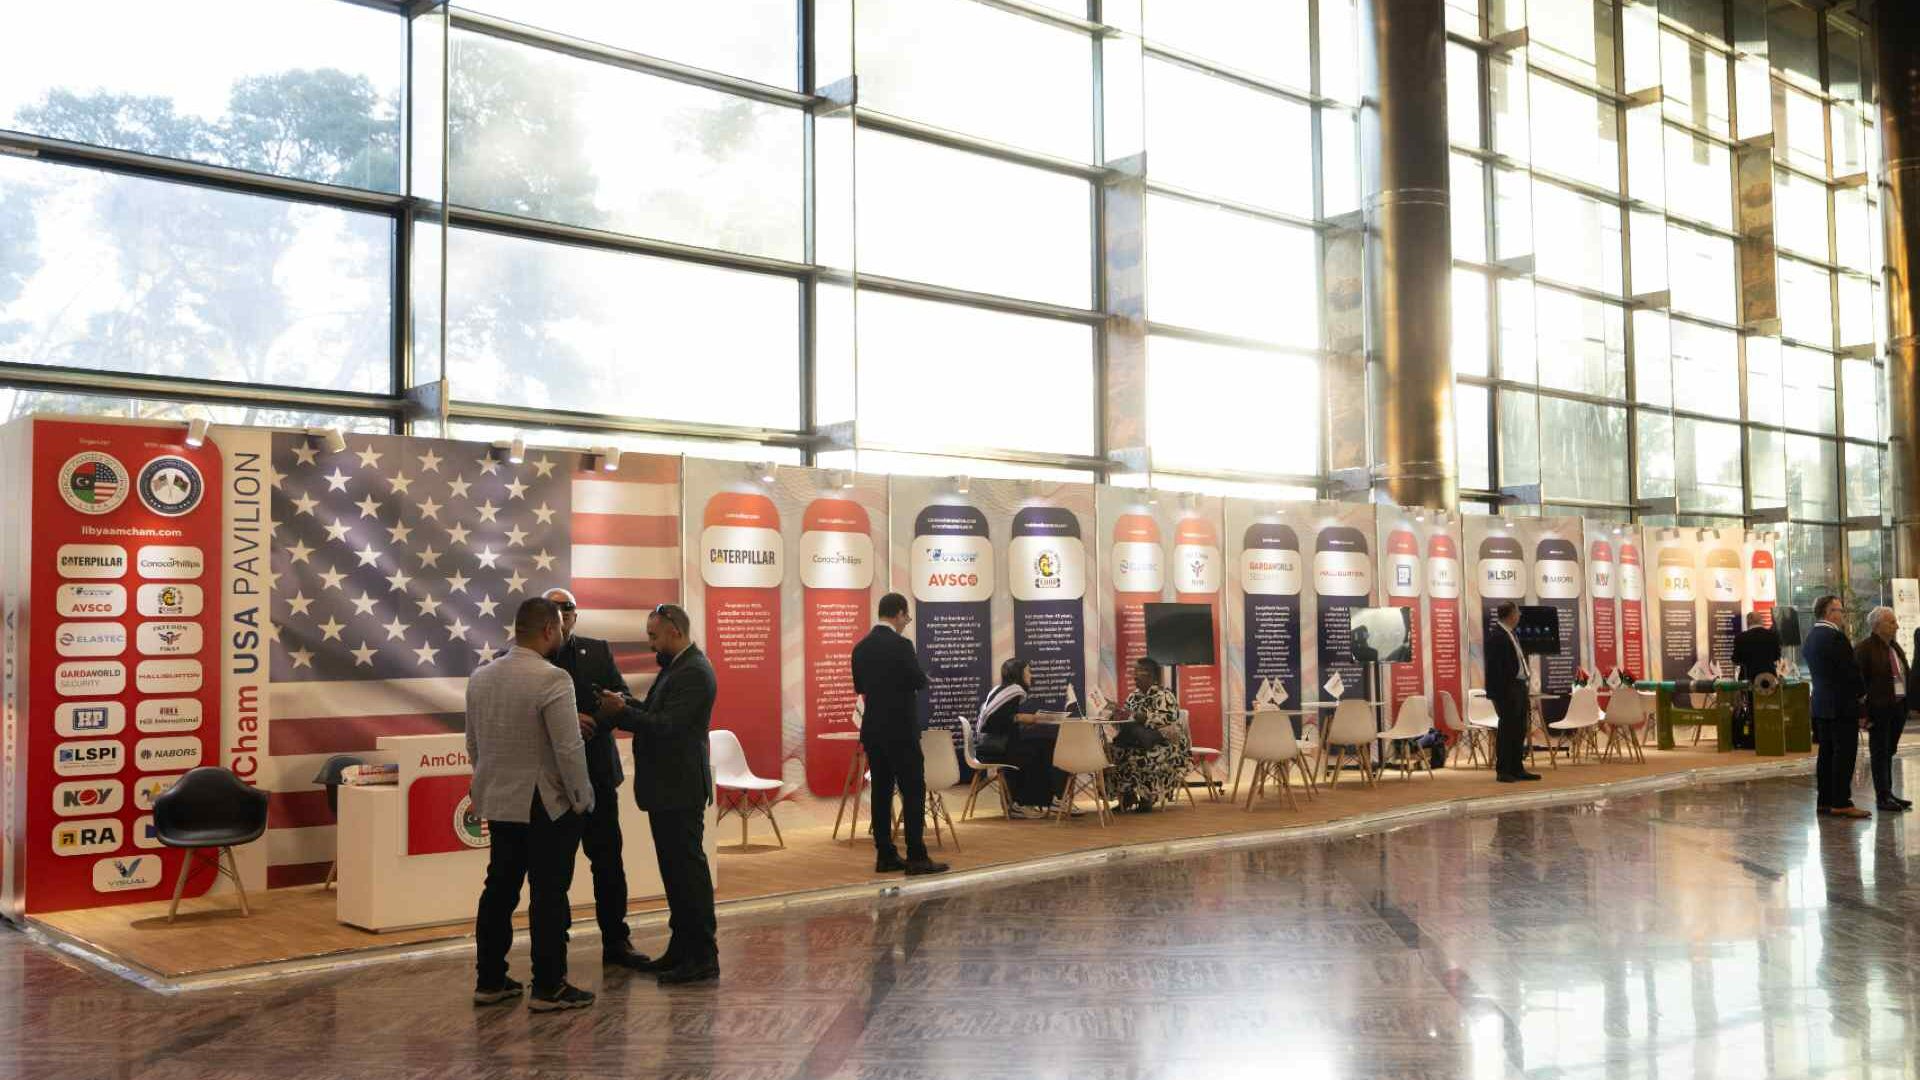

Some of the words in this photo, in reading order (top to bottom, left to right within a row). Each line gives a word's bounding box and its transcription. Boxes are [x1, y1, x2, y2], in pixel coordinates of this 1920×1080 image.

[233, 452, 260, 595] PAVILION
[81, 525, 182, 537] libyaamcham.com
[61, 557, 122, 567] CATERPILLAR
[710, 549, 775, 565] CATERPILLAR
[928, 573, 978, 586] AVSCO
[1495, 570, 1517, 580] LSPI
[72, 603, 112, 612] AVSCO
[77, 635, 123, 643] ELASTEC
[233, 607, 259, 674] USA
[75, 748, 116, 761] LSPI
[154, 748, 198, 758] NABORS
[81, 827, 116, 845] RA
